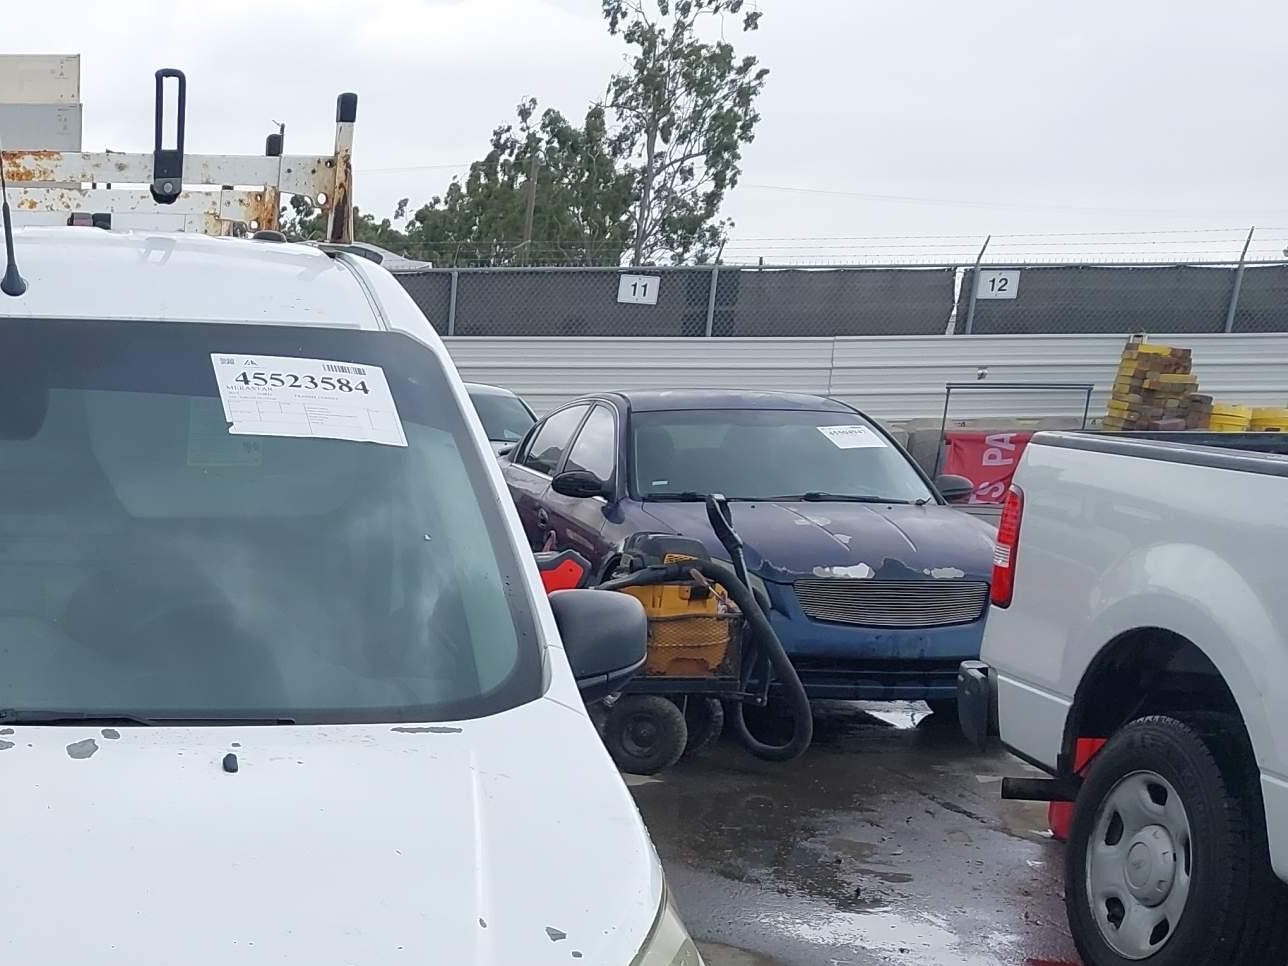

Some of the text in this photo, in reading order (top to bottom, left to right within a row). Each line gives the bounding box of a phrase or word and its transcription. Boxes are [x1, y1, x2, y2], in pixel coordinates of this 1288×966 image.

[631, 282, 648, 297] 11
[988, 277, 1009, 292] 12
[235, 371, 369, 395] 45523584
